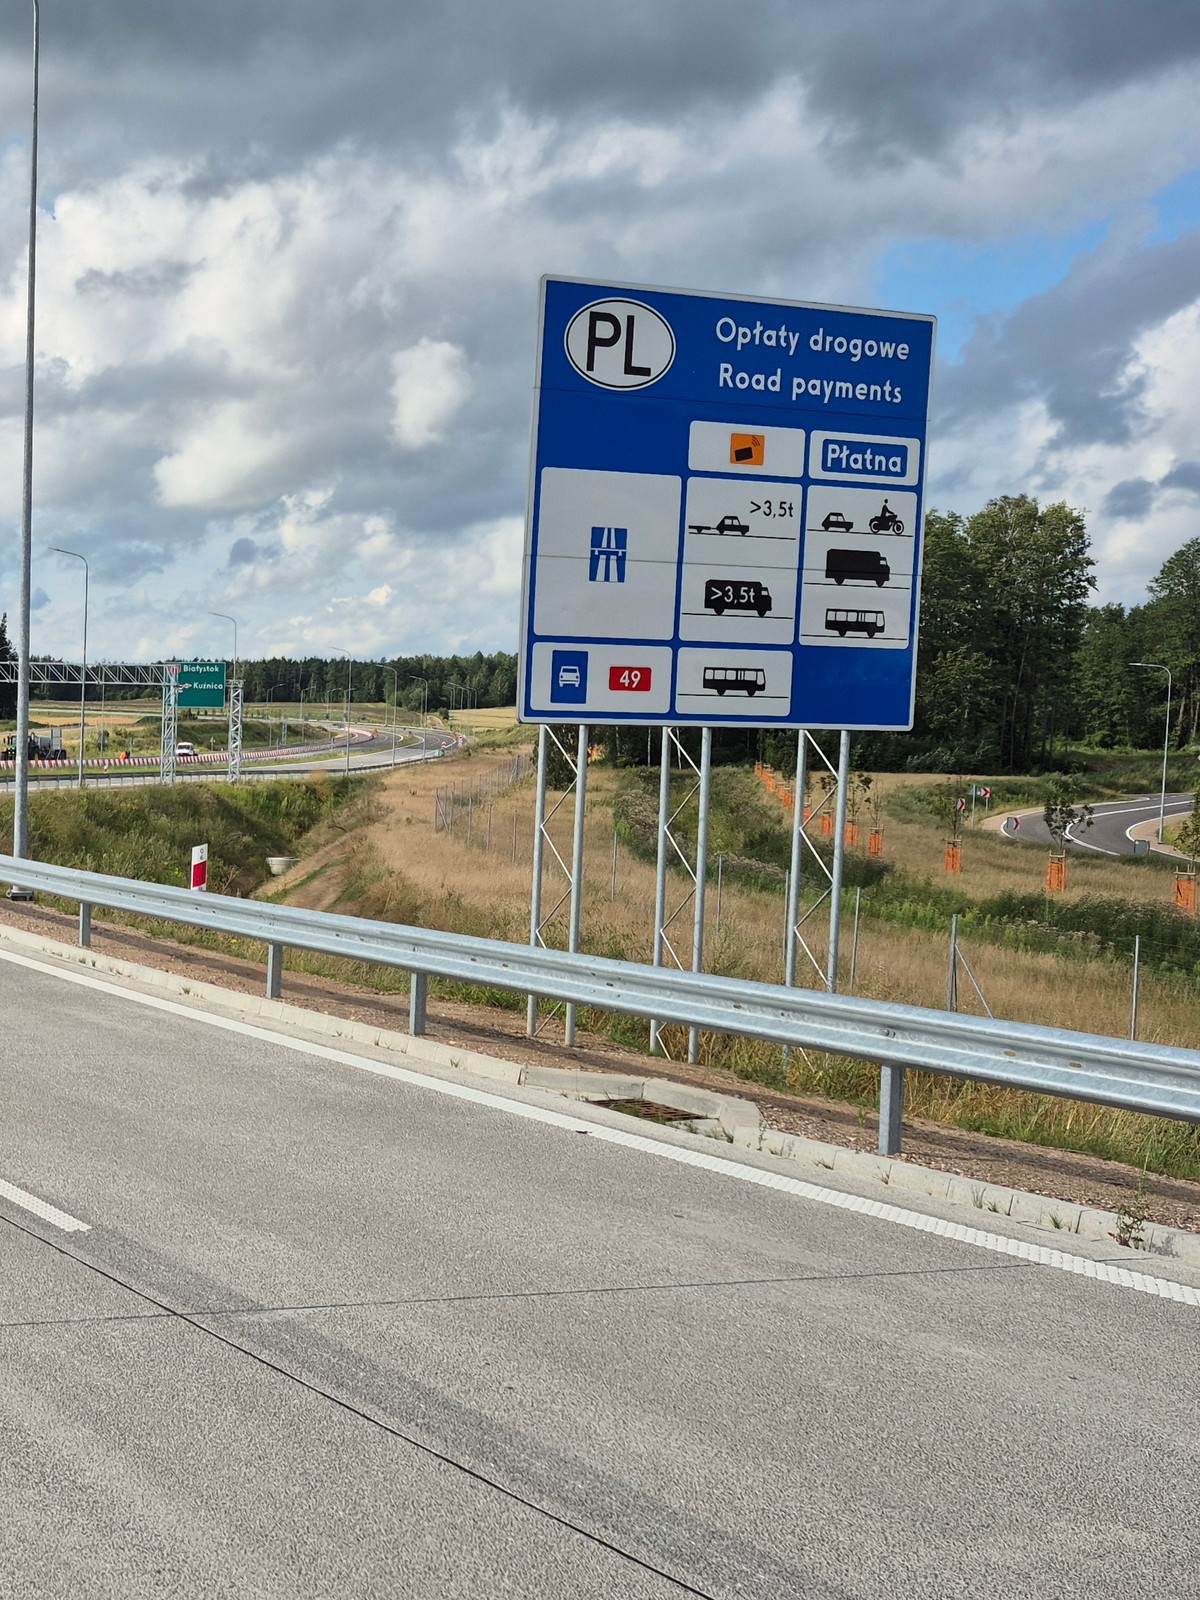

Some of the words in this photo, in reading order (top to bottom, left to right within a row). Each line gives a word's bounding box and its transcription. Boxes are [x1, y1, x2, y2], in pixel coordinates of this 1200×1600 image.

[586, 311, 651, 377] PL
[716, 317, 800, 356] Opłaty
[809, 328, 910, 362] drogowe
[719, 363, 782, 392] Road
[792, 370, 902, 404] payments
[826, 444, 902, 473] Płatna
[183, 665, 219, 674] Białystok
[619, 670, 641, 688] 49
[193, 682, 223, 690] Kuźnica
